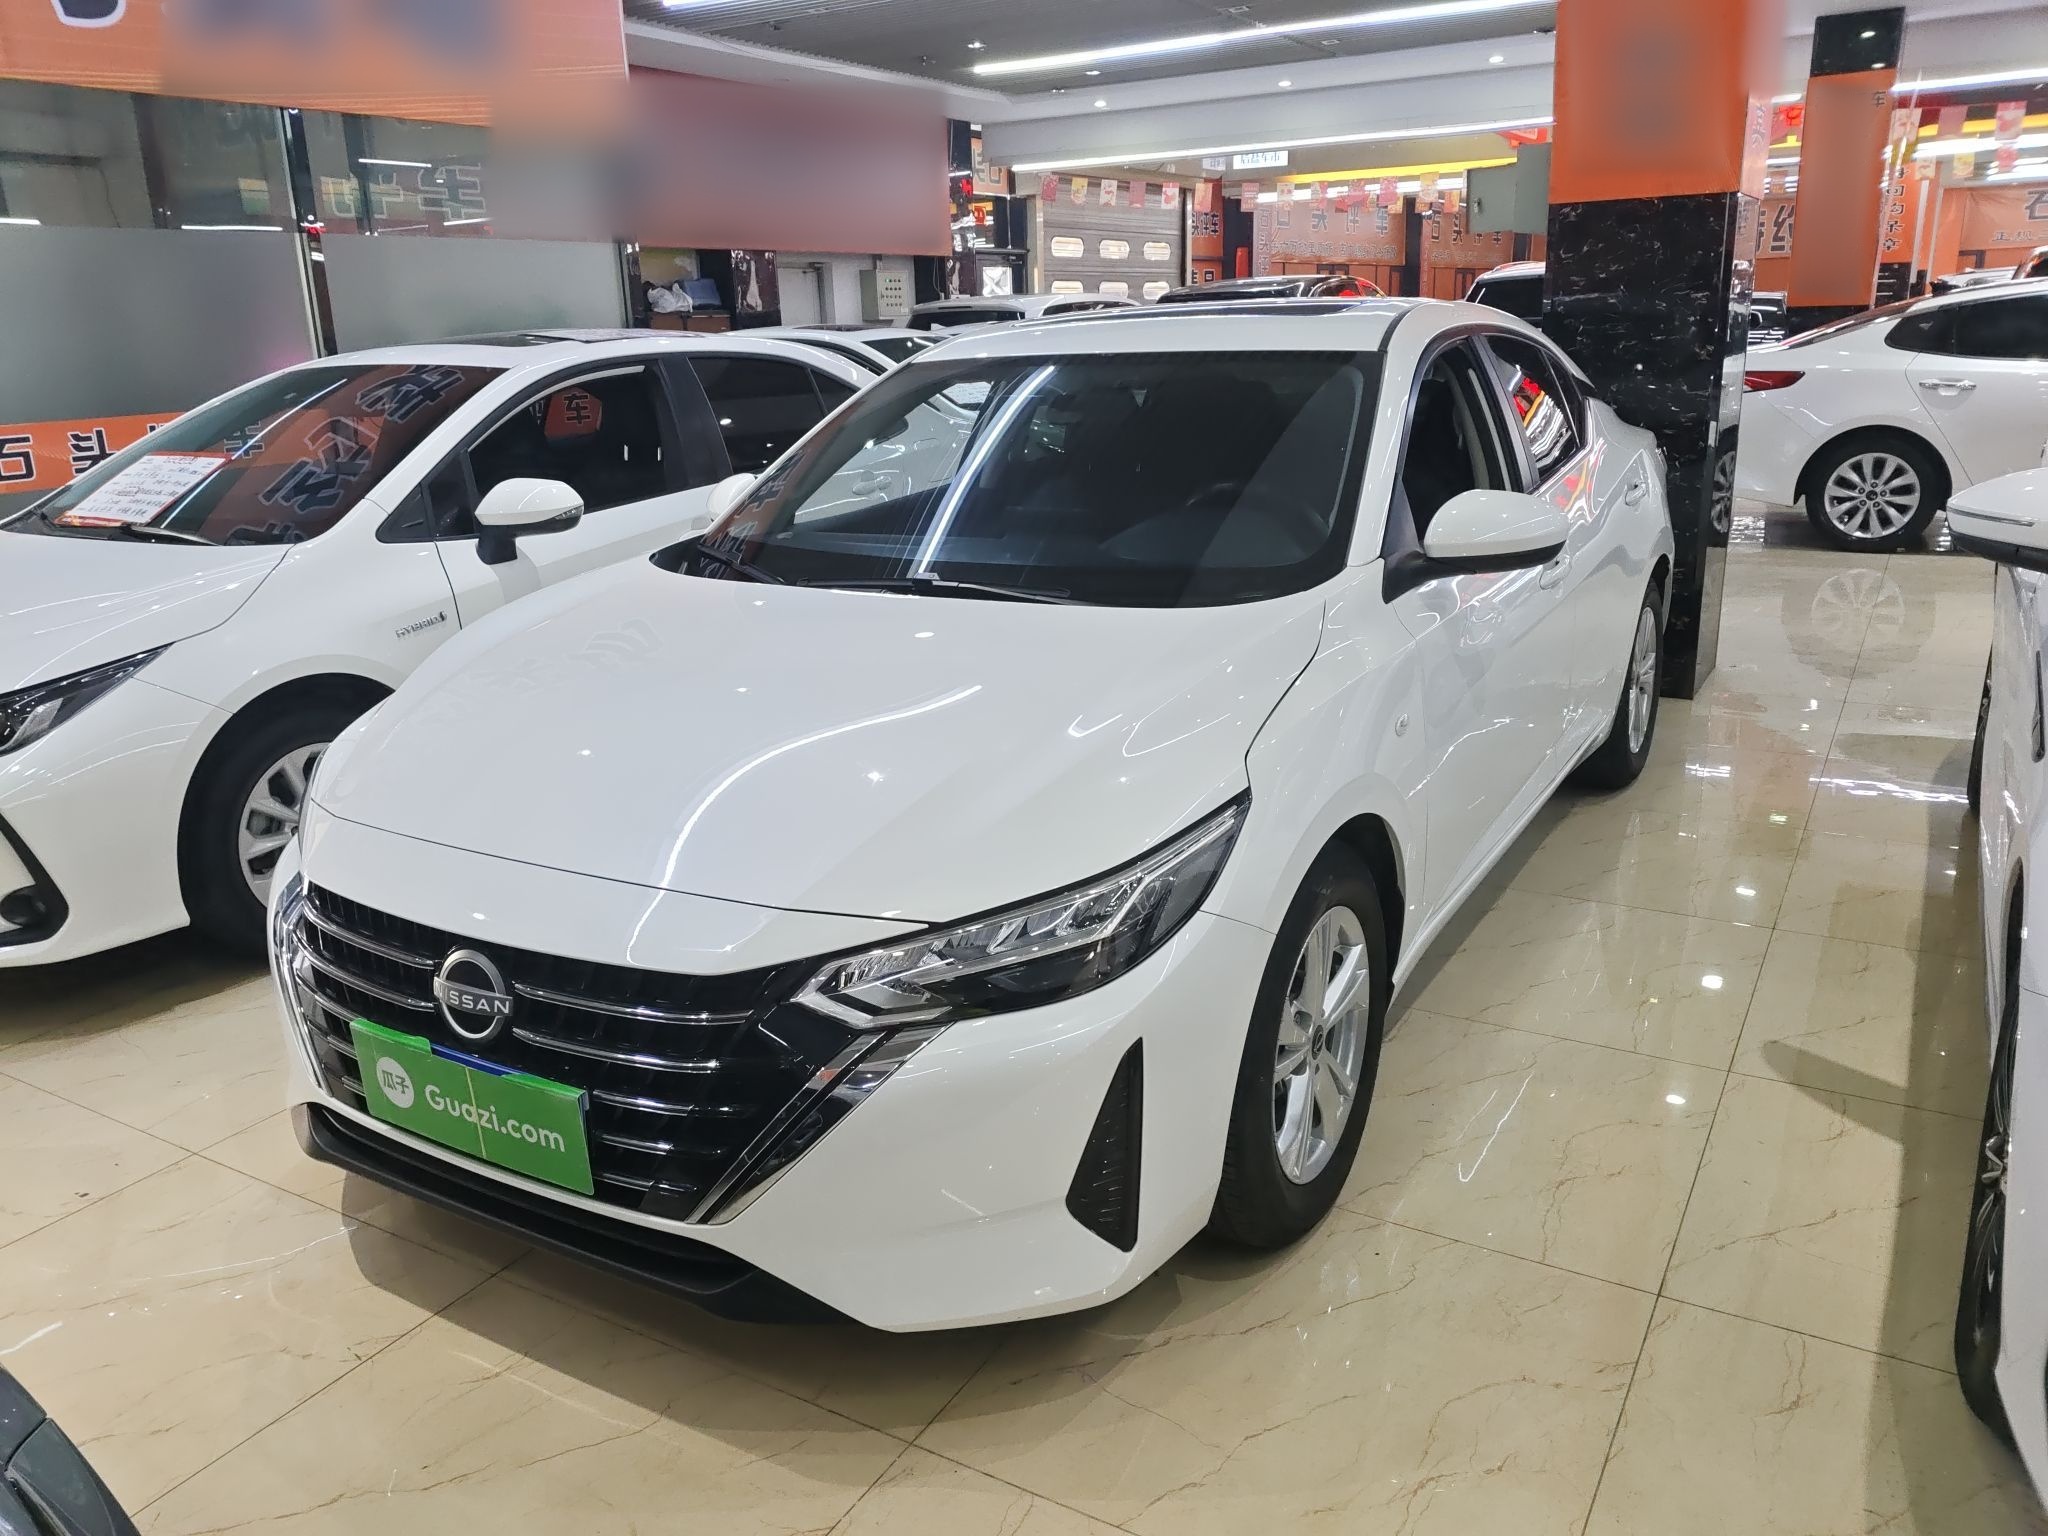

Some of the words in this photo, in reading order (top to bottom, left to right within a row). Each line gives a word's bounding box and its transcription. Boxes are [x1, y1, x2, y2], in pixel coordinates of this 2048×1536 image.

[433, 981, 511, 1014] NISSAN
[381, 1068, 410, 1097] 瓜子
[424, 1084, 567, 1153] Guazi.com
